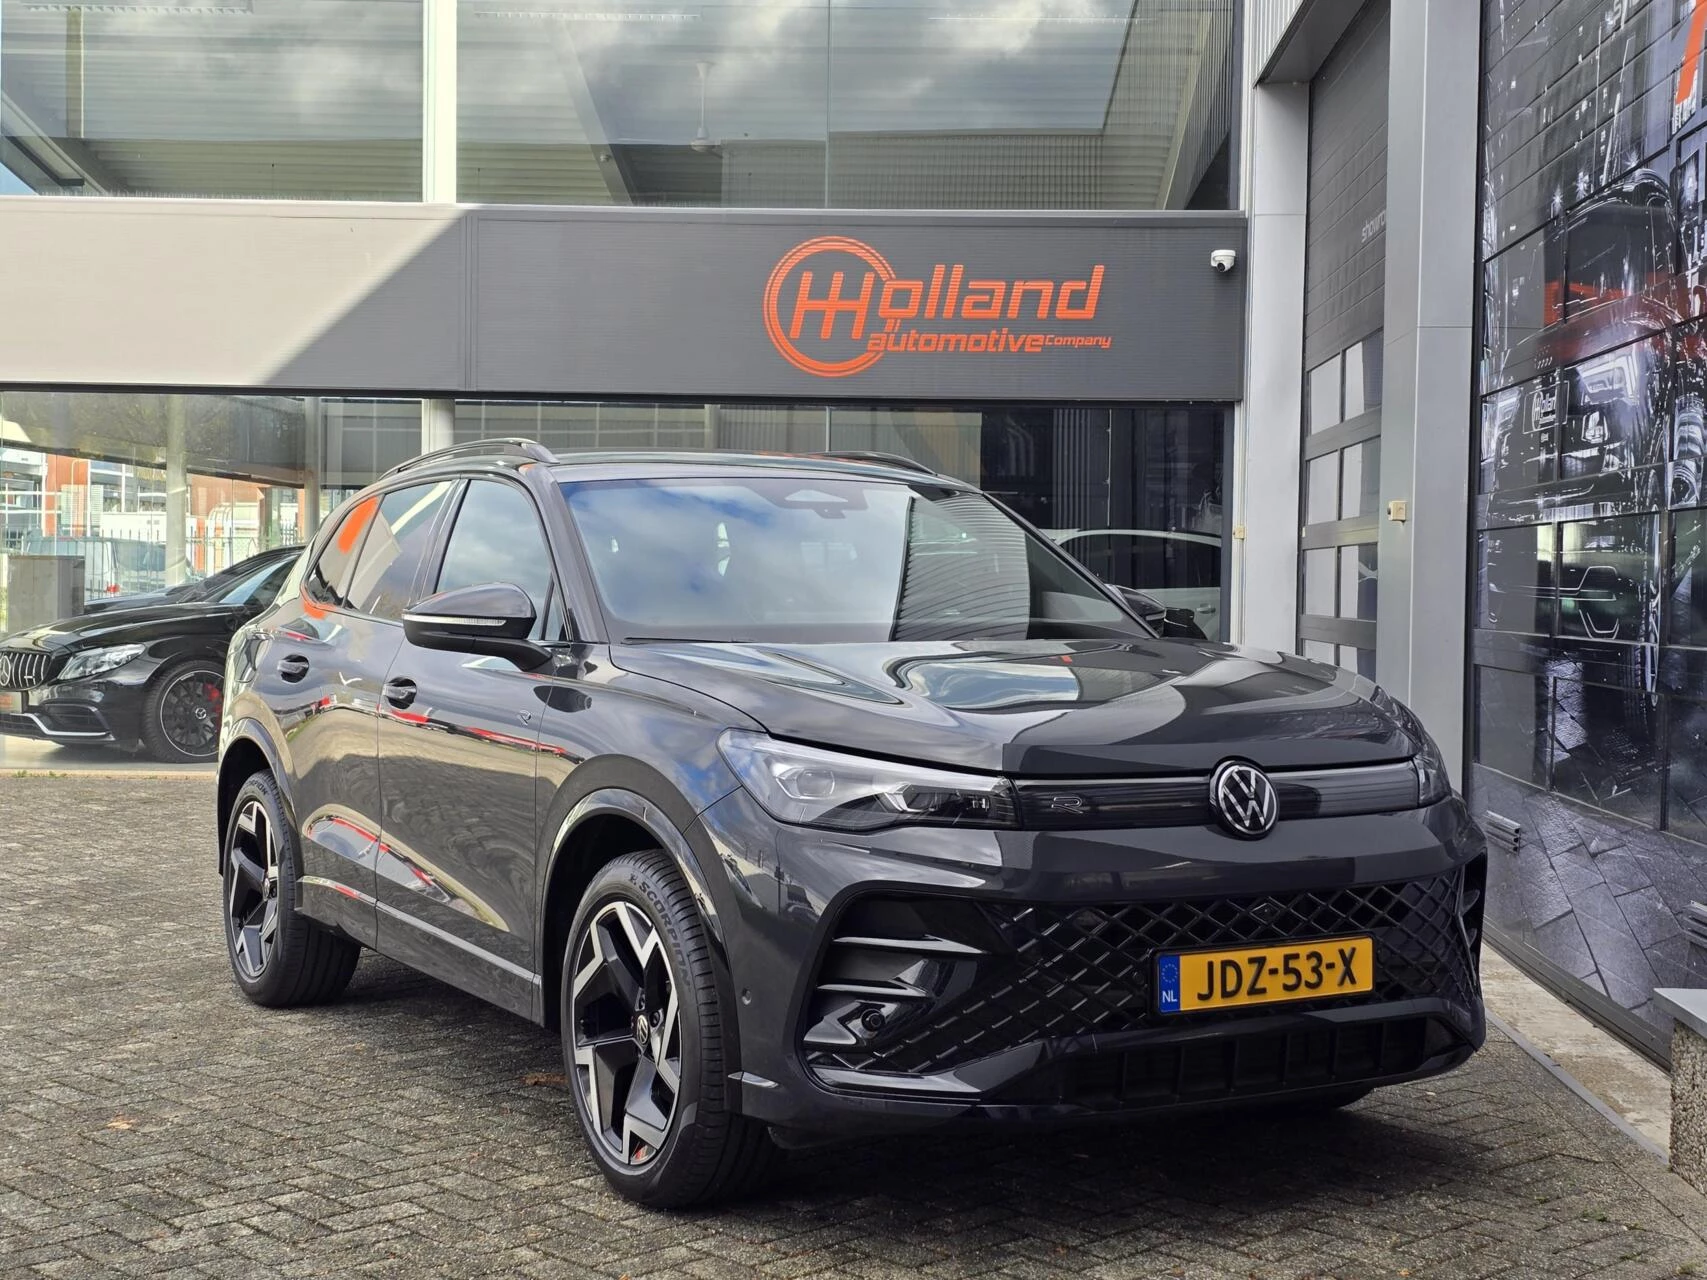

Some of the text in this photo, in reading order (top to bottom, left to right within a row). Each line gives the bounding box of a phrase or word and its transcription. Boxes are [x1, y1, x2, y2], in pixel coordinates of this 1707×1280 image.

[867, 328, 1112, 353] automotive Company
[1197, 947, 1357, 1002] JDZ-53-X
[1162, 990, 1178, 1003] NL
